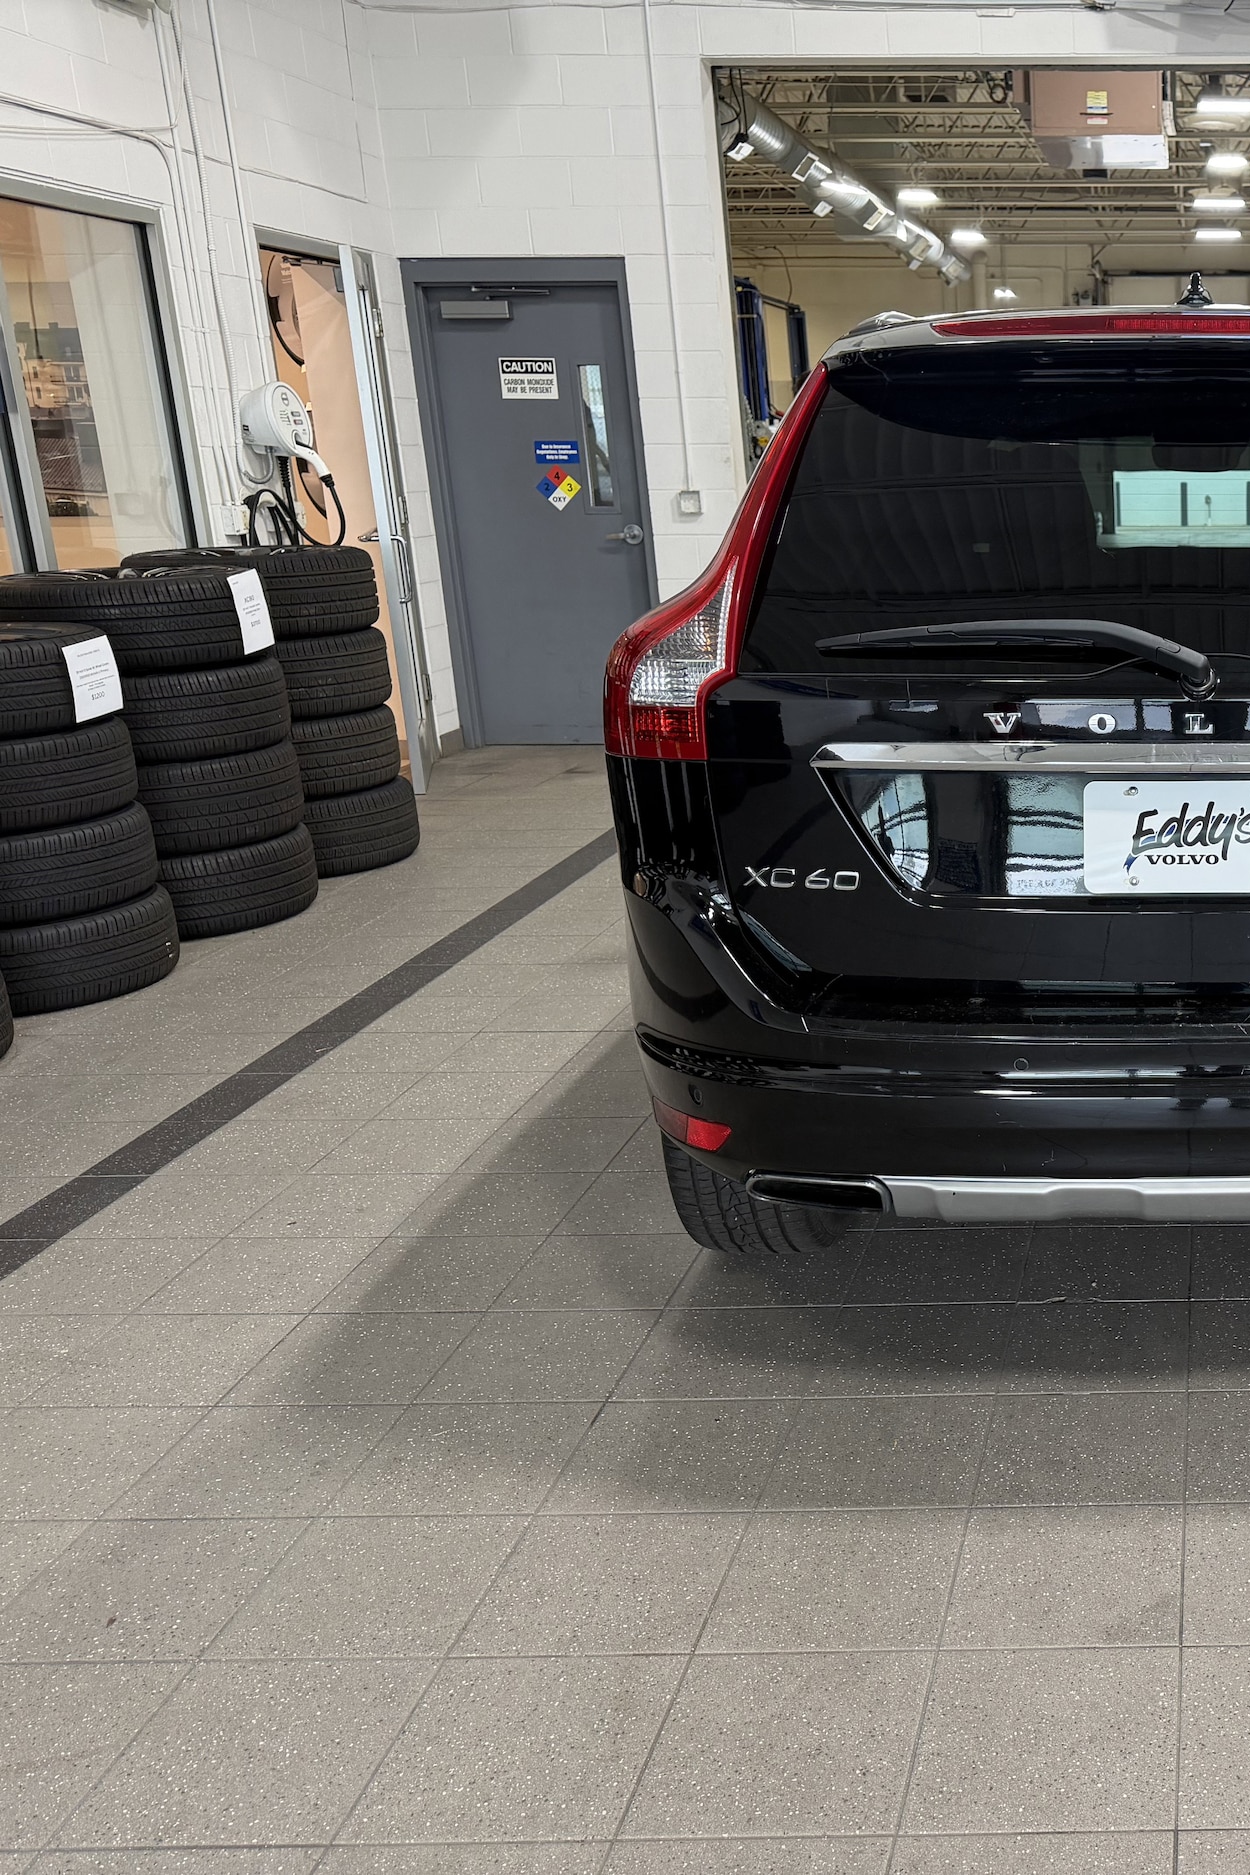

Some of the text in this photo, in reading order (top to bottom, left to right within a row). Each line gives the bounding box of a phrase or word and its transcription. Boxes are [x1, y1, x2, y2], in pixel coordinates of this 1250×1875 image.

[502, 361, 553, 372] CAUTION
[503, 378, 554, 386] CARBON MONOXIDE
[554, 471, 560, 480] 4
[544, 482, 573, 492] 2 3
[1144, 854, 1219, 865] VOLVO
